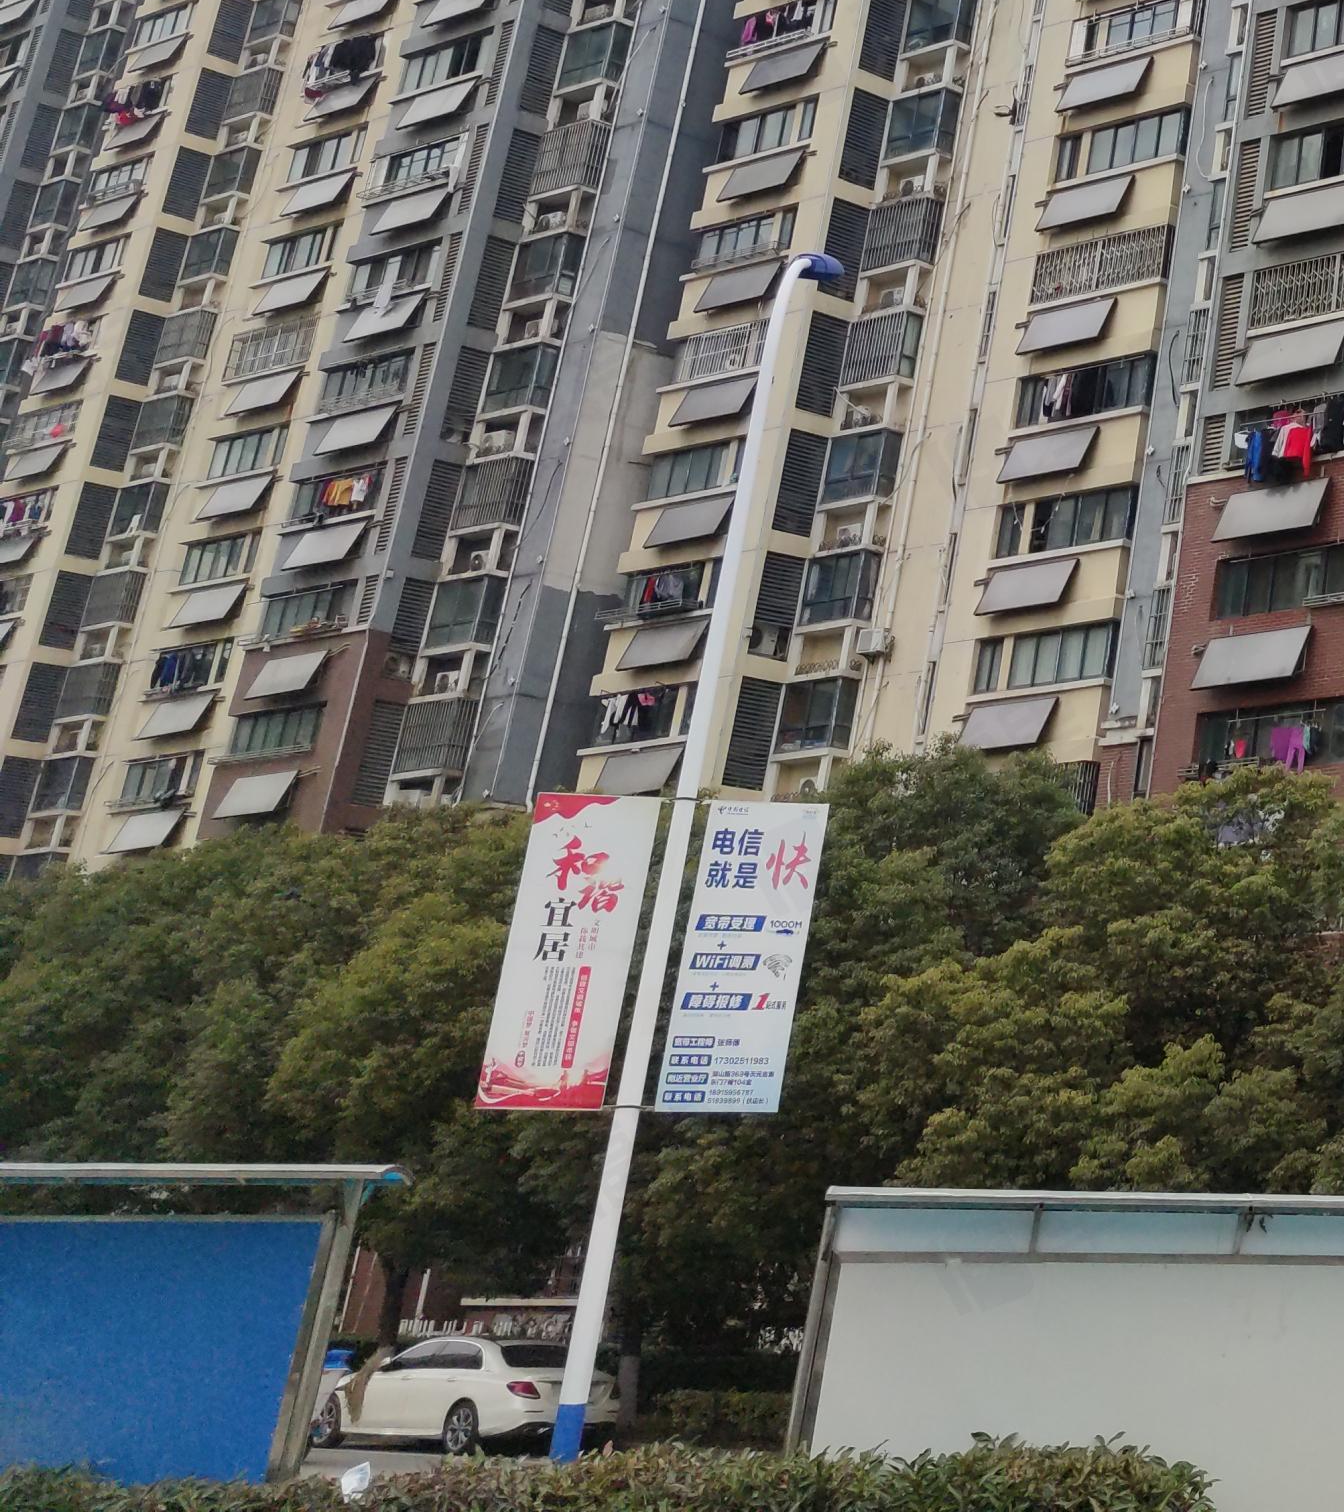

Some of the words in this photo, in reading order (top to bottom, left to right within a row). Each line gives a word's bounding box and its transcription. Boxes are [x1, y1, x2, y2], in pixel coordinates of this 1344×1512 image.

[712, 828, 764, 856] 电信
[546, 835, 625, 913] 和谐
[705, 861, 758, 889] 就是
[766, 832, 811, 890] 快
[533, 897, 578, 961] 宜居
[770, 920, 802, 928] 1000M
[689, 995, 743, 1009] 障碍报修
